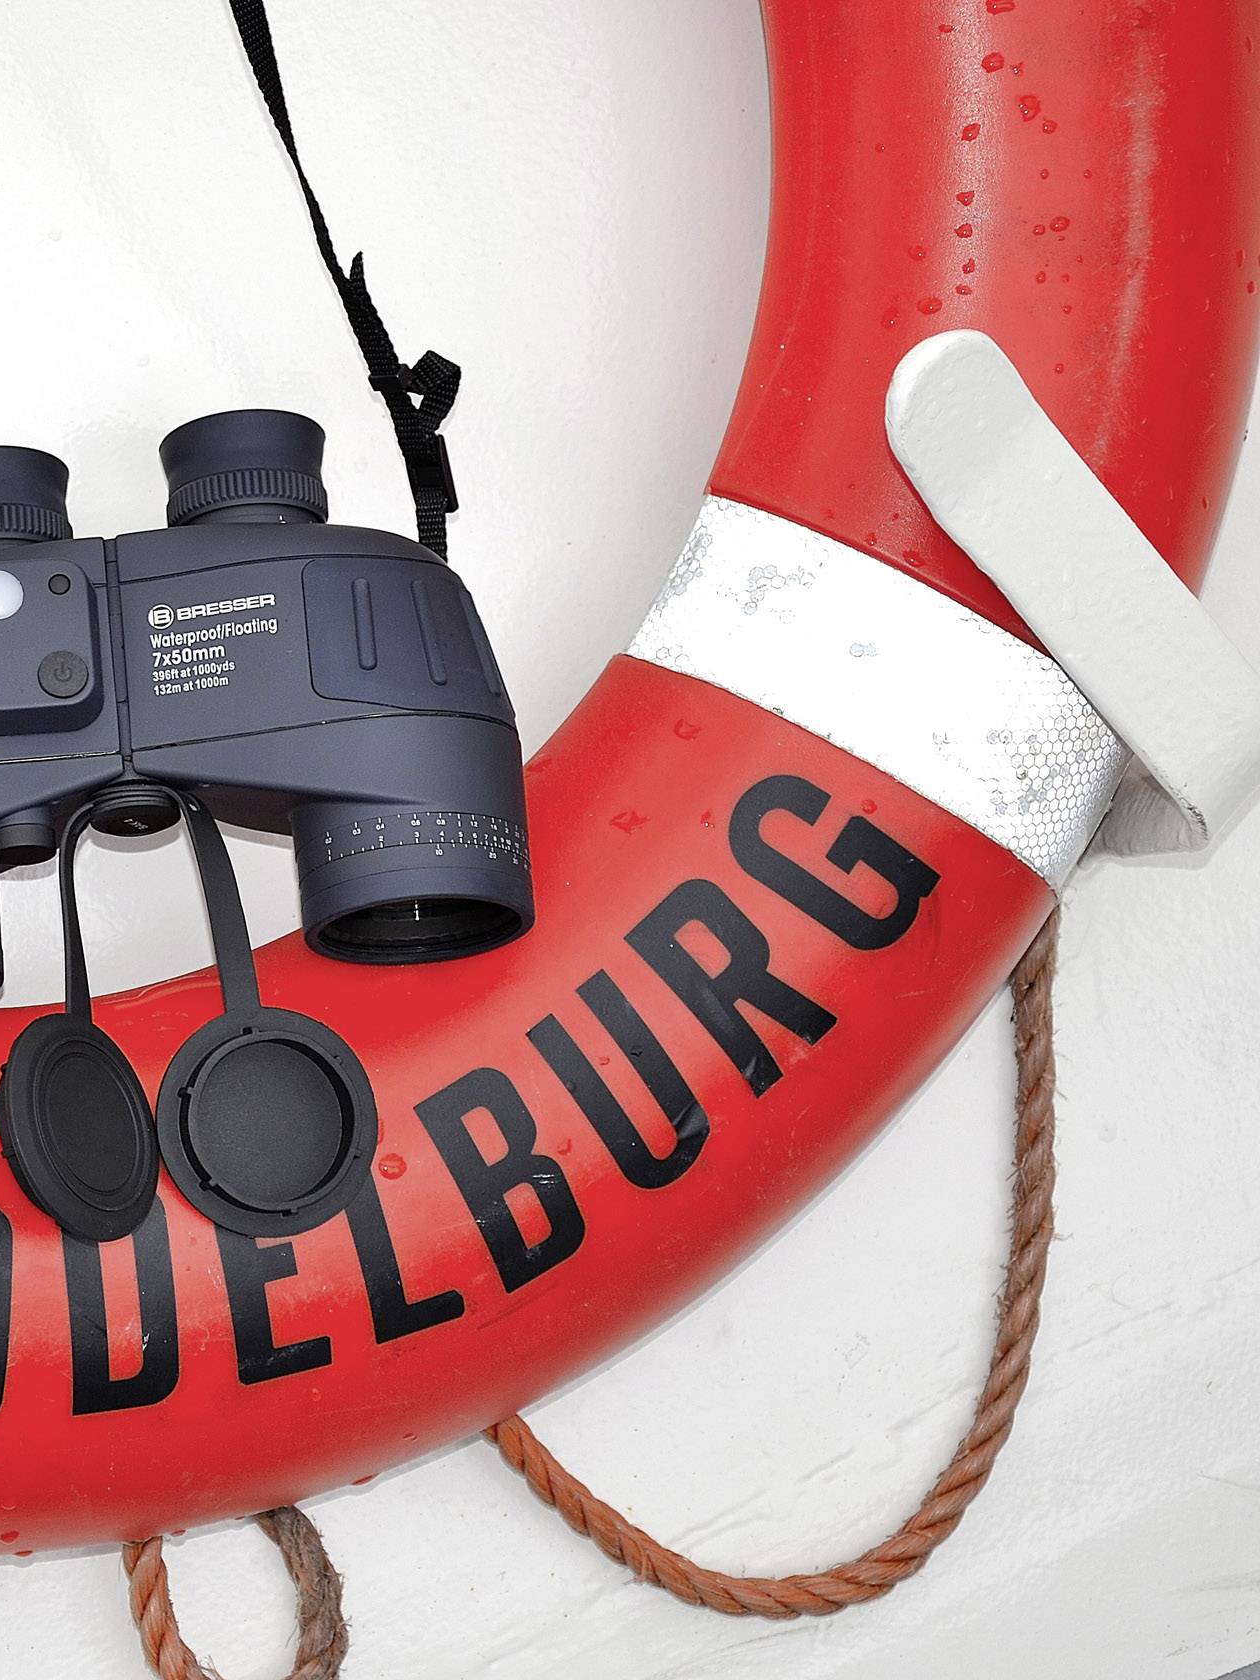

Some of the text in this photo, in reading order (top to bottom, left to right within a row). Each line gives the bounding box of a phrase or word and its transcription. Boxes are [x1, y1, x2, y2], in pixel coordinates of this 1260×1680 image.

[176, 594, 276, 621] BRESSER
[149, 618, 278, 649] Waterproof/Floating
[152, 645, 225, 667] 7x50mm
[152, 660, 236, 682] 396ft at 1000yds
[153, 676, 229, 696] 132m at 1000m
